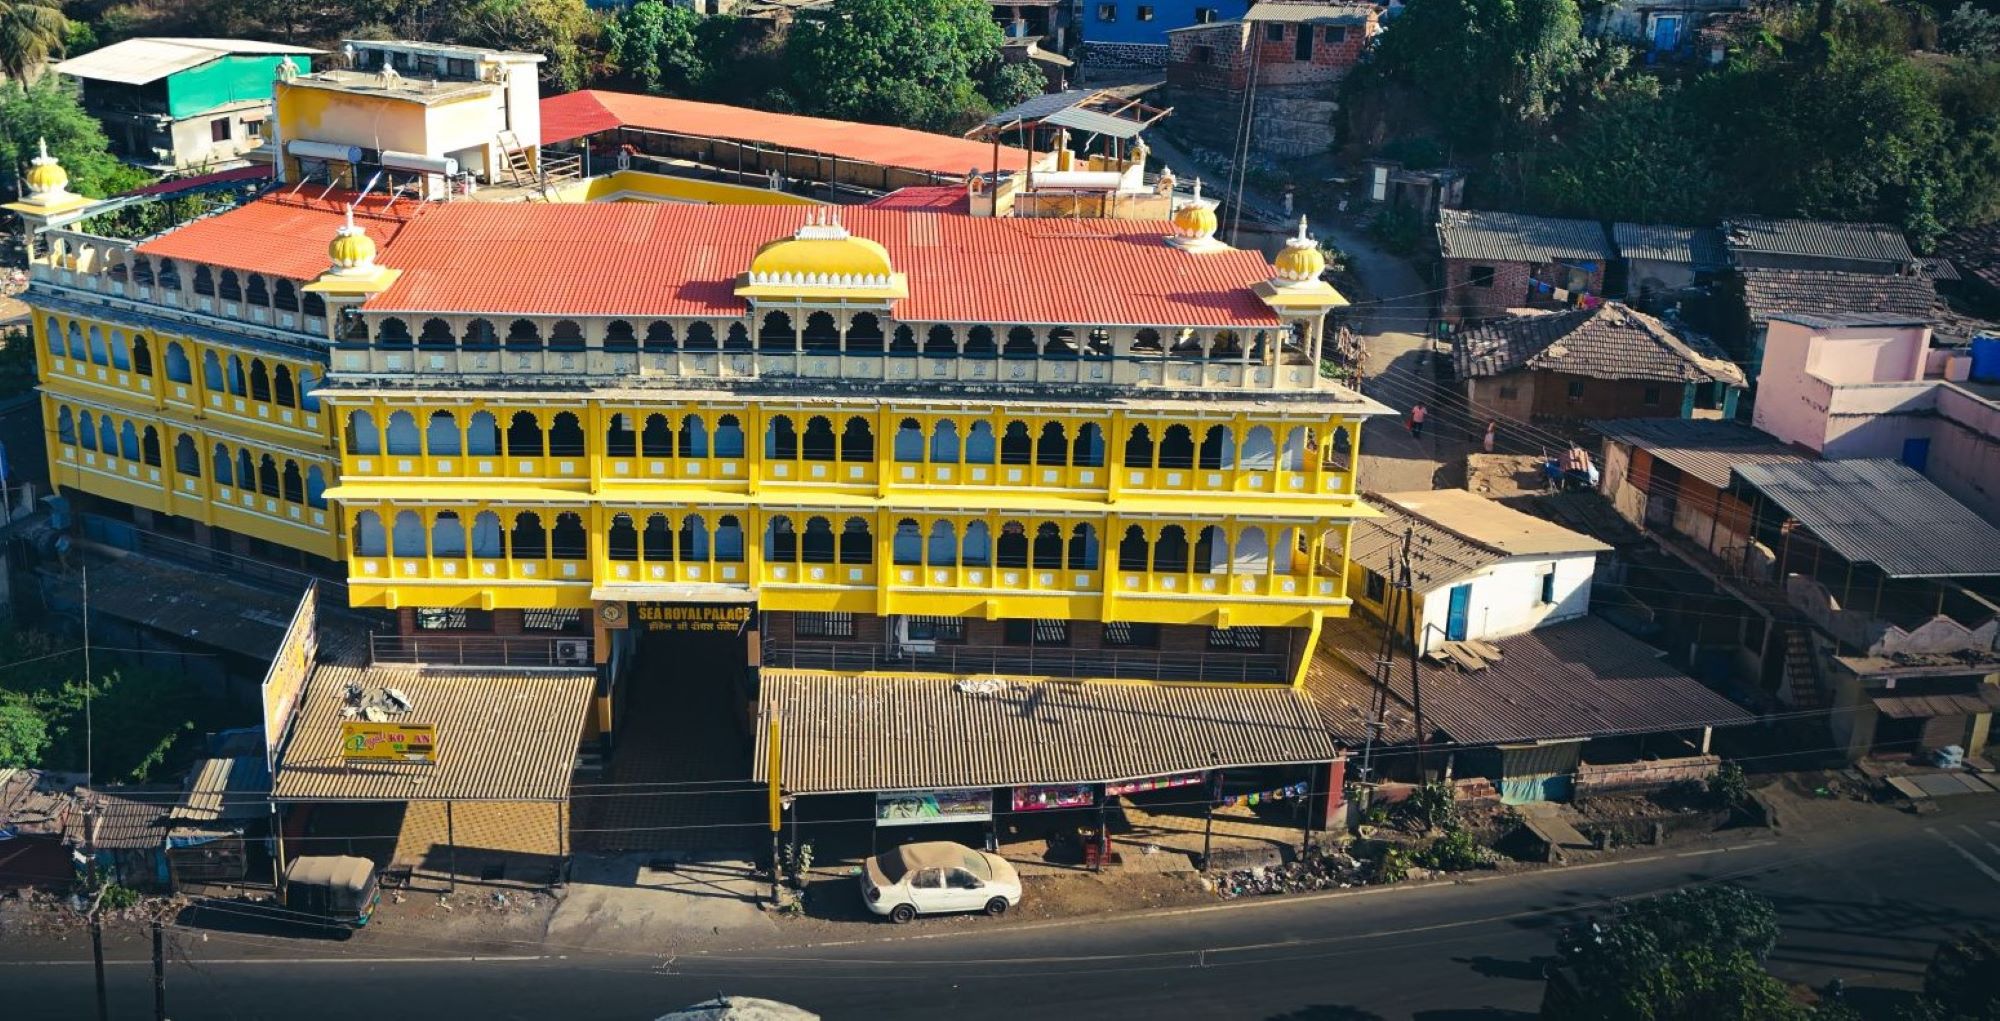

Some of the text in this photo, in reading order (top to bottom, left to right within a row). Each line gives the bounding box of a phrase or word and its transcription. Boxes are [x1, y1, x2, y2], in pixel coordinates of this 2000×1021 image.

[639, 607, 662, 620] SEA
[664, 607, 702, 620] ROYAL
[704, 607, 751, 621] PALACE
